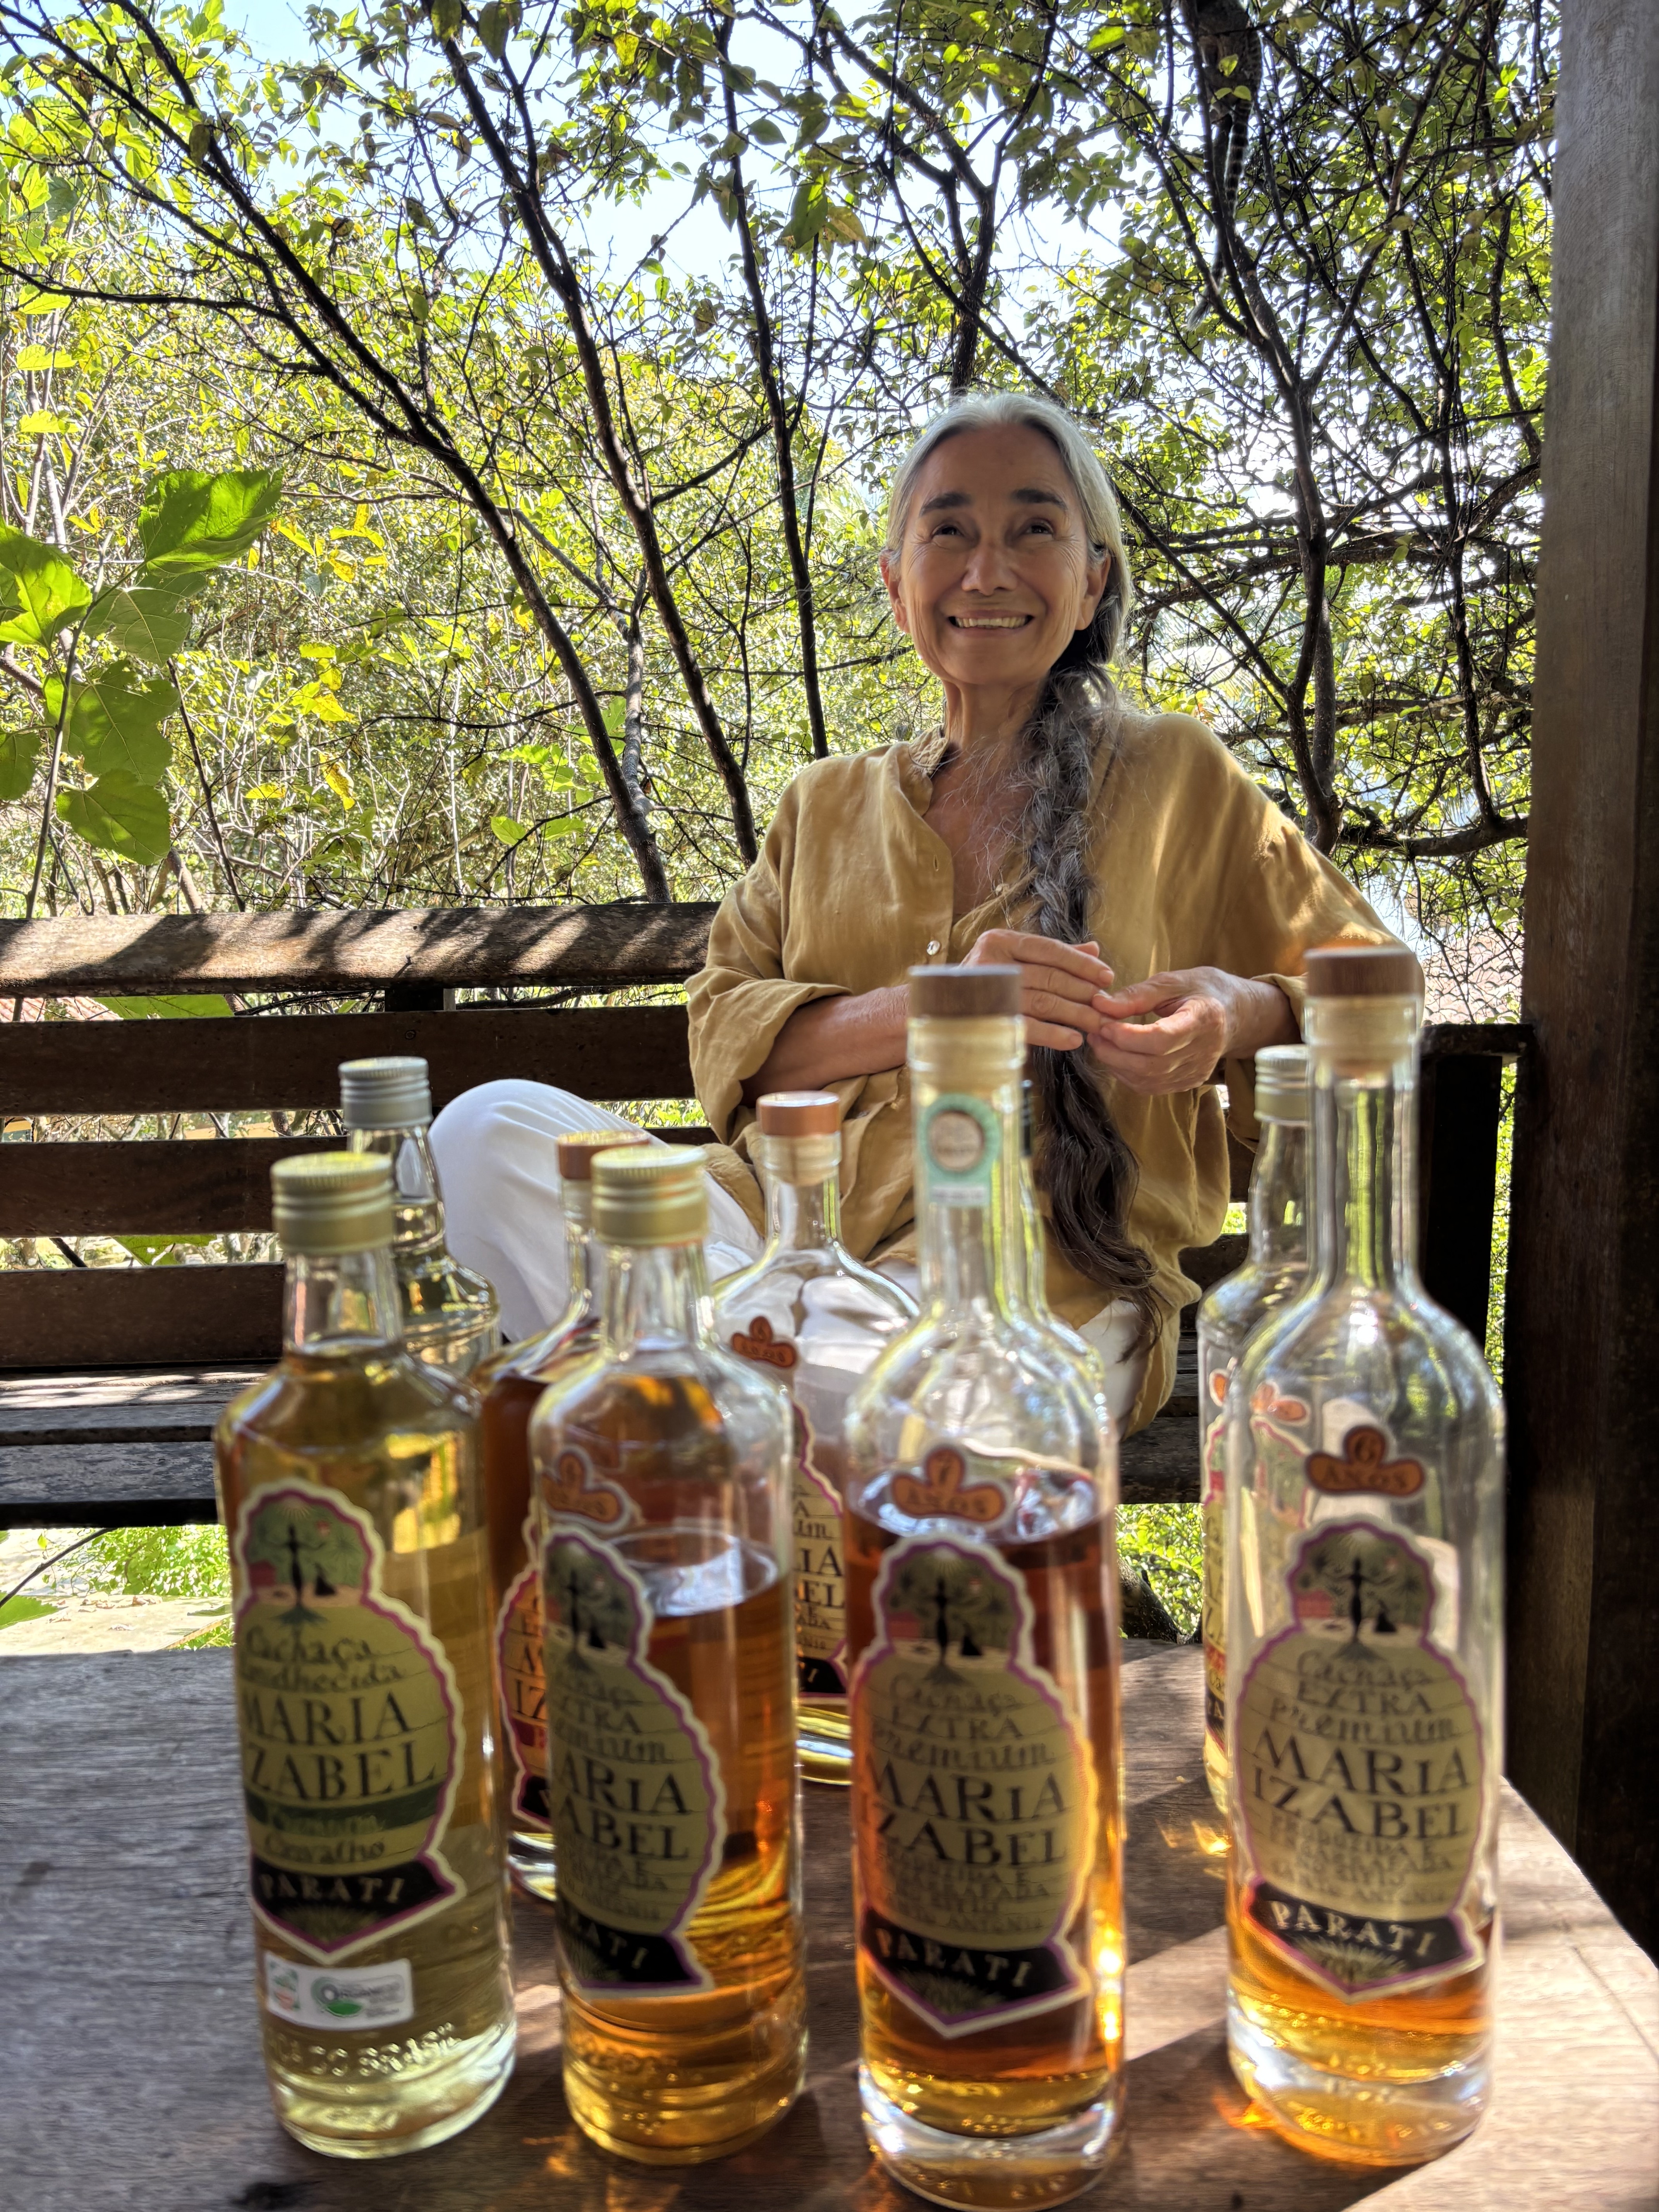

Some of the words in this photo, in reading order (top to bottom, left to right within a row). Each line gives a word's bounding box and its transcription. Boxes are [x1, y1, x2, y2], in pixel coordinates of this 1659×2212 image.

[904, 1486, 986, 1515] ANOS
[1324, 1465, 1408, 1490] ANOS
[1270, 1697, 1458, 1743] Premium
[1298, 1680, 1432, 1715] EXTRA
[246, 1740, 436, 1801] ZABEL
[556, 1749, 693, 1816] ARIA
[864, 1751, 1067, 1822] MARIA
[1253, 1728, 1470, 1795] MARIA
[558, 1793, 690, 1860] ABEL
[1254, 1767, 1470, 1839] IZABEL
[258, 1873, 405, 1904] PARATI
[876, 1927, 1032, 1987] PARATI
[1270, 1900, 1435, 1957] PARATI
